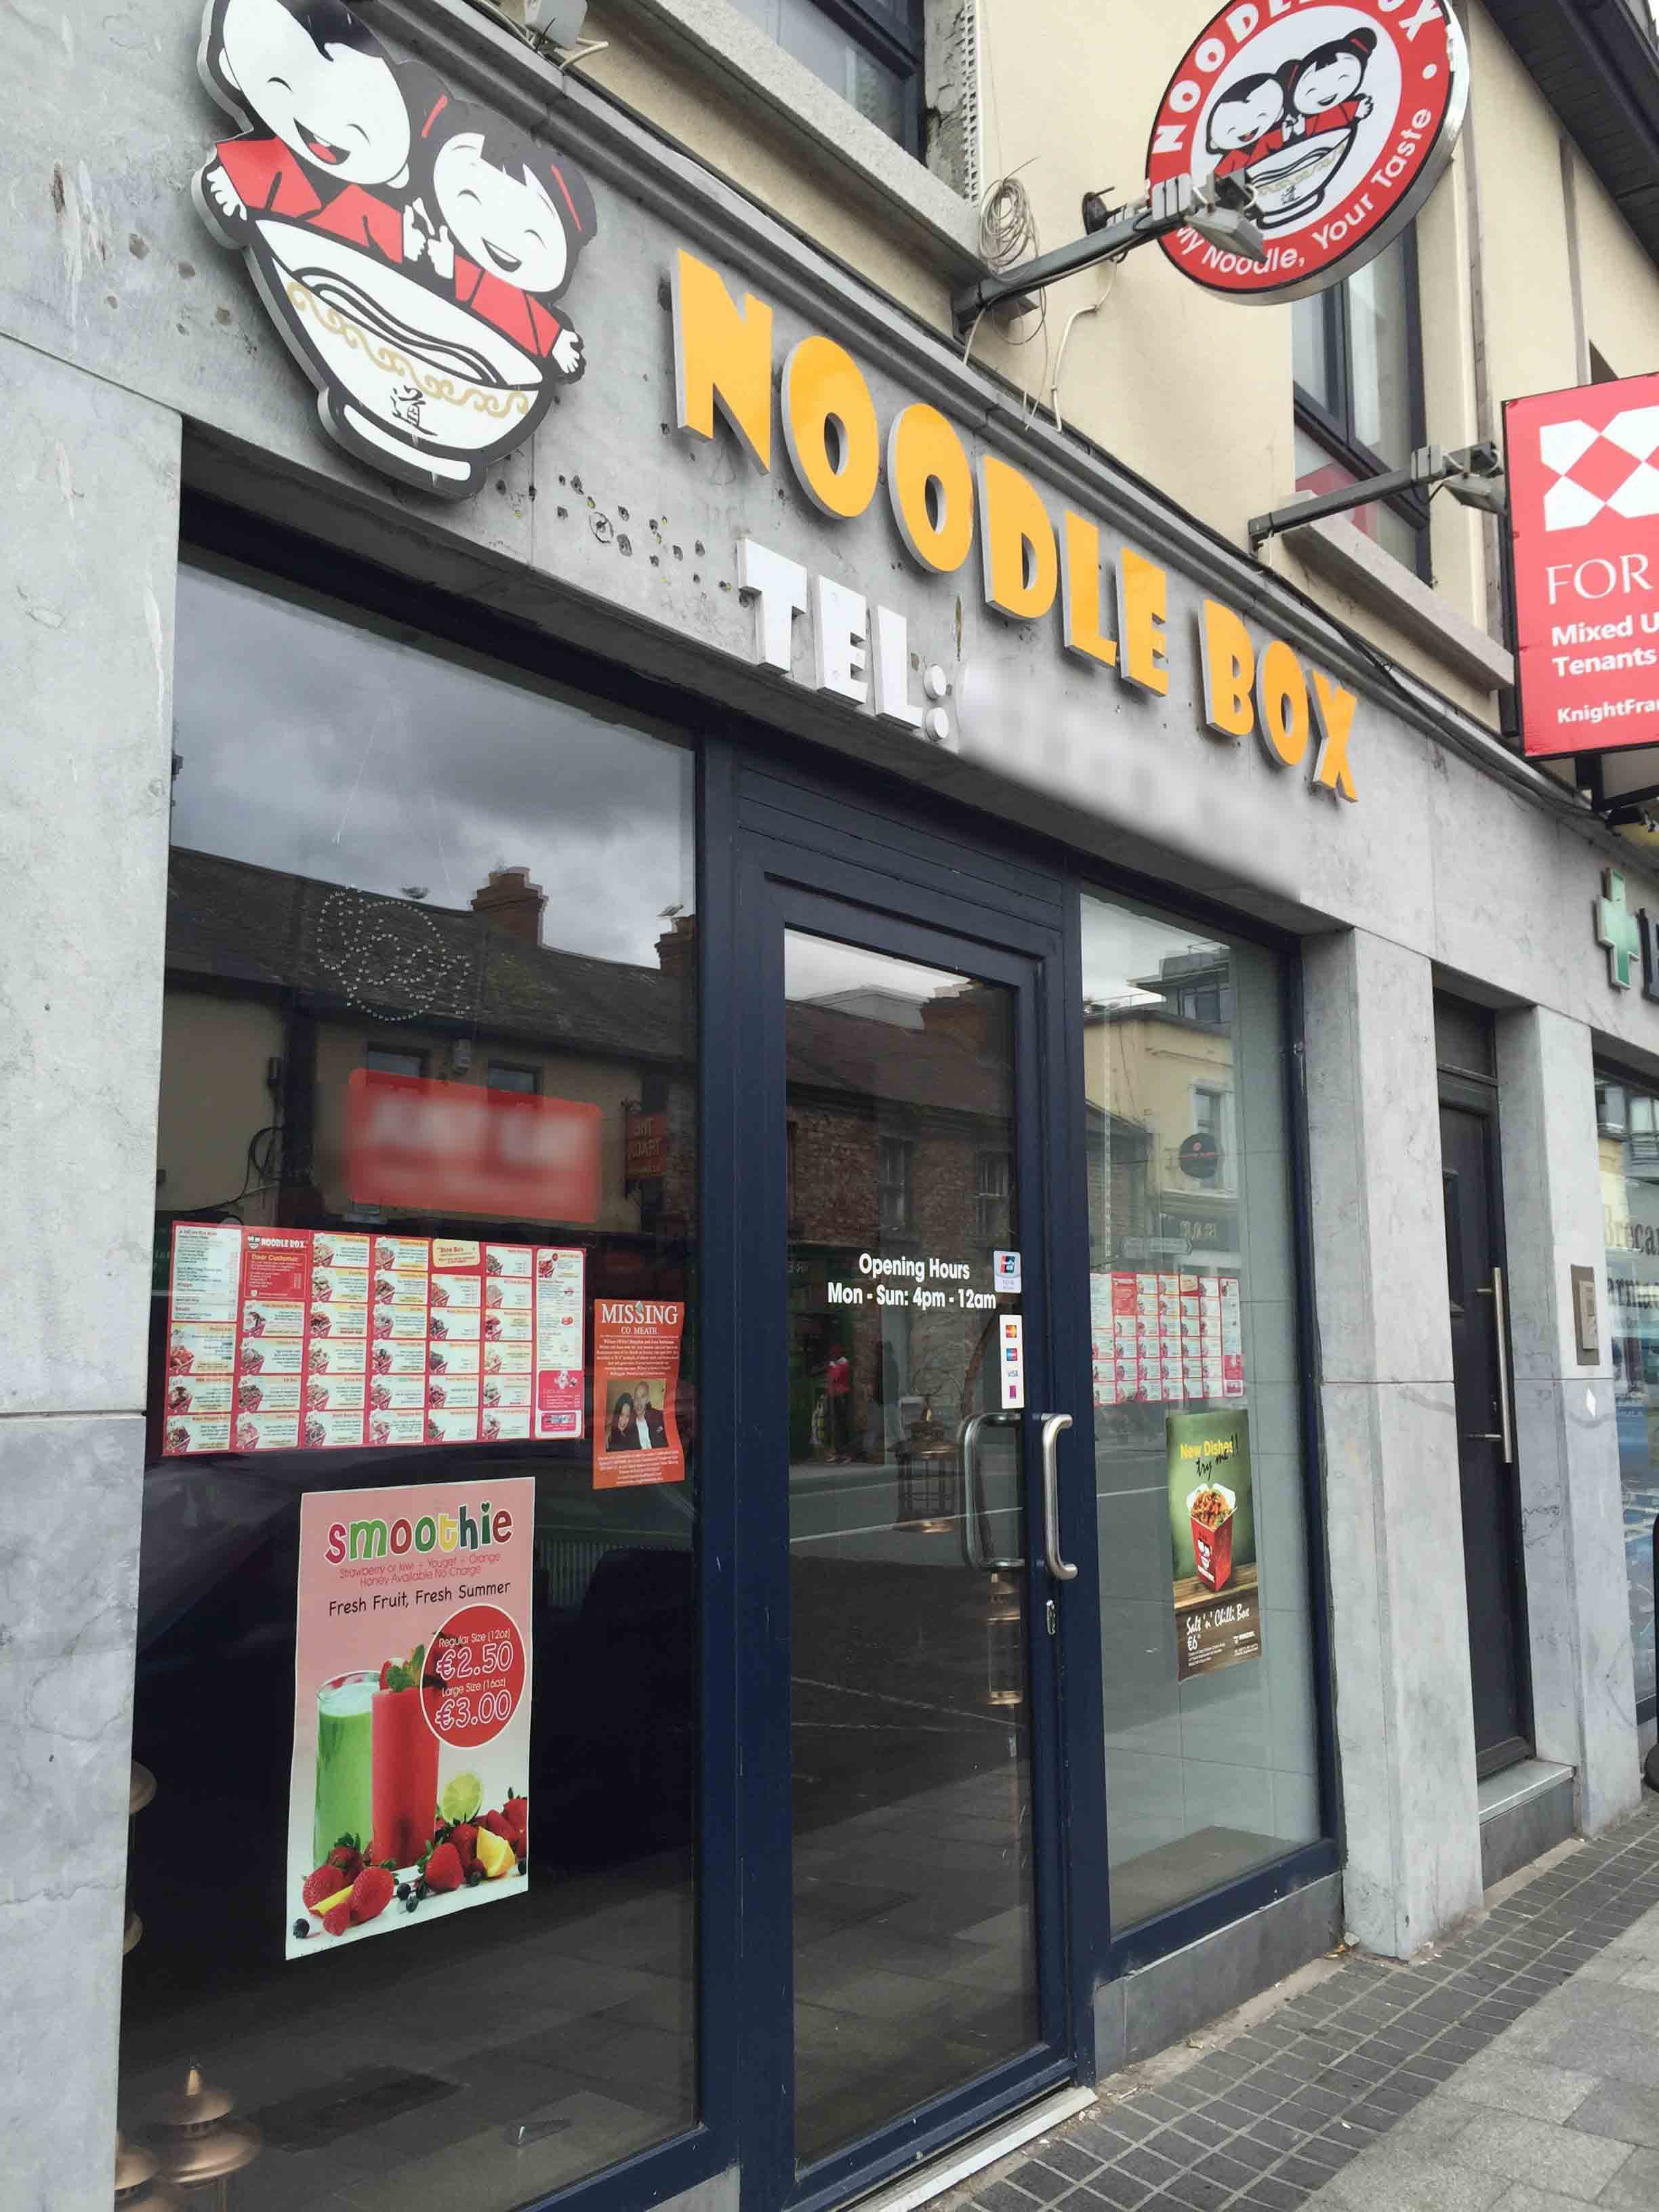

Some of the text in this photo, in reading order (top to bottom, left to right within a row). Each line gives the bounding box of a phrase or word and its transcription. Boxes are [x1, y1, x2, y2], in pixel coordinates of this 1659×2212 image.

[1312, 193, 1375, 249] Your
[1371, 108, 1431, 189] Taste
[674, 248, 1357, 803] NOODLE BOX
[1545, 553, 1654, 605] FOR
[1551, 615, 1634, 647] Mixed
[1552, 647, 1658, 677] Tenants
[1557, 699, 1659, 724] KnightFra
[859, 1253, 970, 1282] Opening Hours
[827, 1282, 863, 1304] Mon
[876, 1284, 909, 1306] Sun:
[912, 1286, 946, 1311] 4pm
[958, 1288, 997, 1310] 12am
[601, 1303, 678, 1325] MISSING
[1180, 1438, 1233, 1460] New Dishes
[1197, 1457, 1212, 1482] try
[325, 1500, 514, 1564] smoothie
[360, 1564, 482, 1587] Honey Available No Charge
[329, 1581, 510, 1616] Fresh Fruit, Fresh Summer
[1186, 1616, 1202, 1635] Salt
[1214, 1605, 1235, 1626] Chilli
[1236, 1603, 1250, 1621] Box
[439, 1635, 470, 1648] Regular
[471, 1633, 487, 1643] Size
[436, 1640, 514, 1681] €2.50
[442, 1685, 464, 1698] Large
[466, 1682, 481, 1692] Size
[435, 1689, 512, 1732] €3.00
